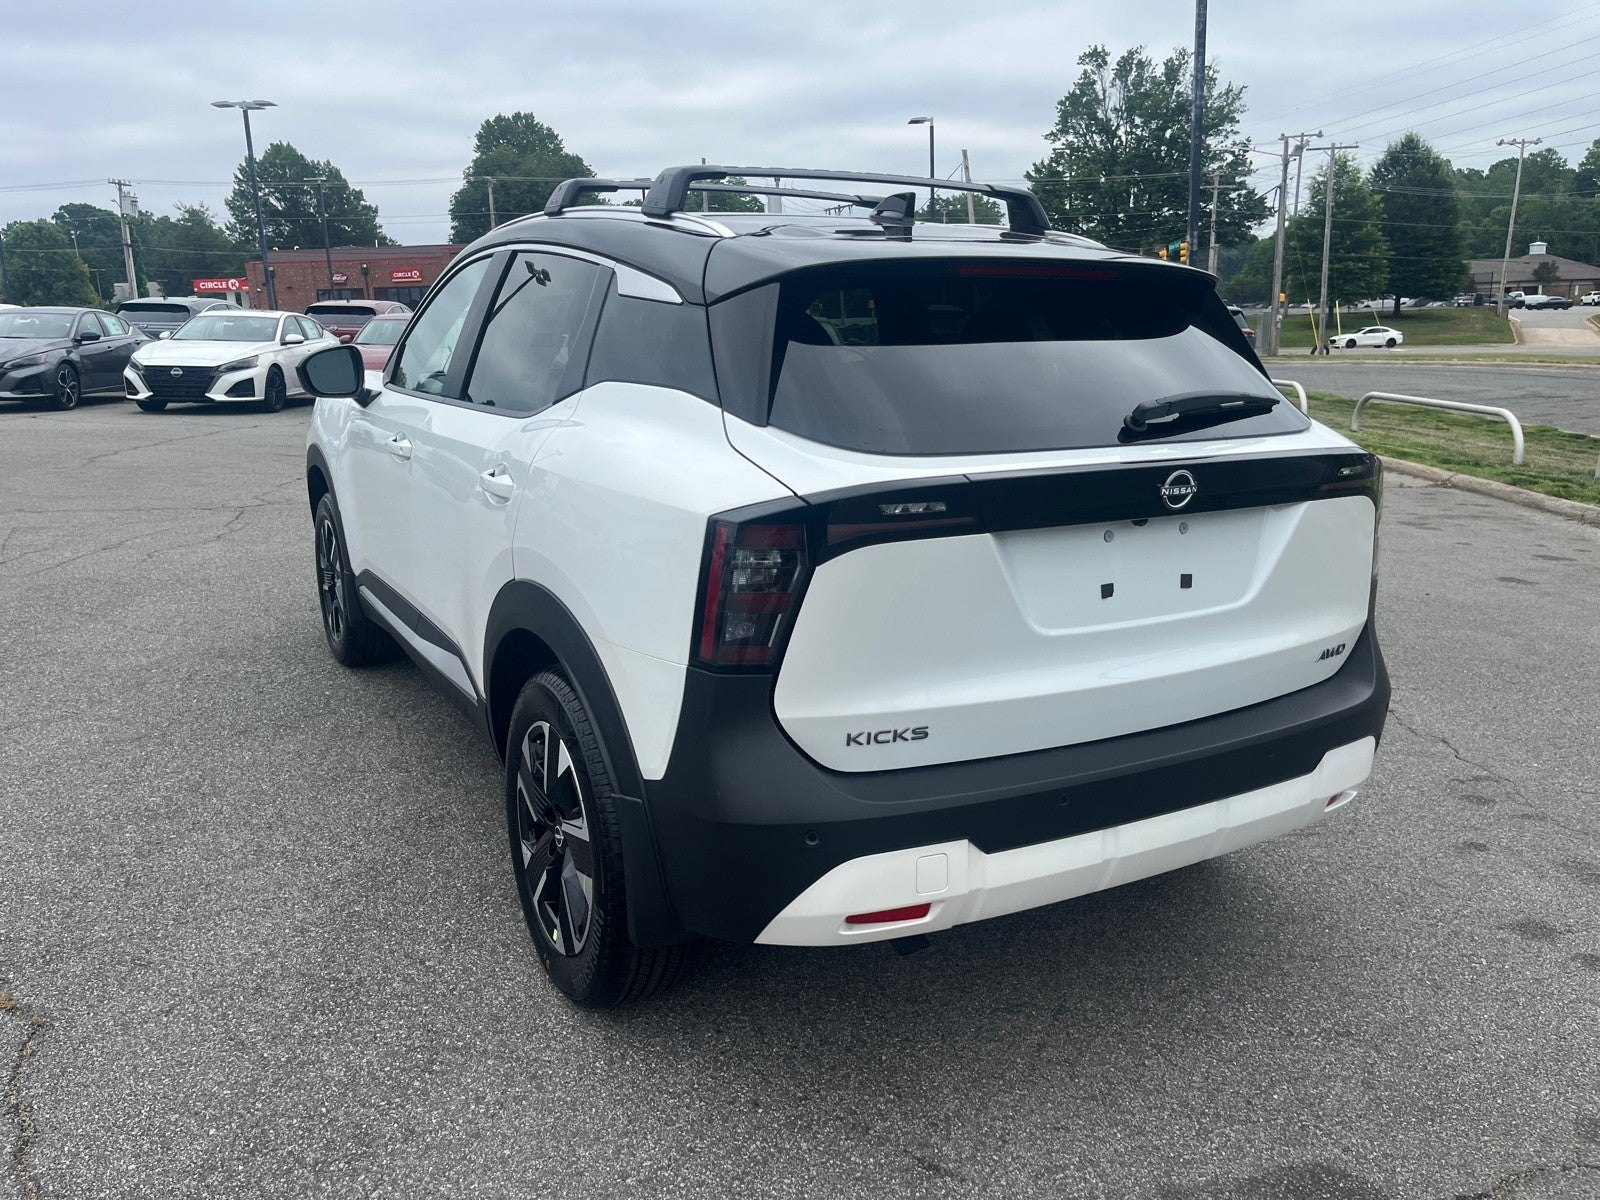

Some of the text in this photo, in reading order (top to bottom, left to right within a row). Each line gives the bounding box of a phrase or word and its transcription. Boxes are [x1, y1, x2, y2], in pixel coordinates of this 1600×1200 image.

[412, 270, 420, 278] K
[199, 280, 239, 290] CIRCLE K
[1160, 485, 1198, 496] NISSAN
[1315, 643, 1346, 663] AWD
[845, 725, 929, 747] KICKS
